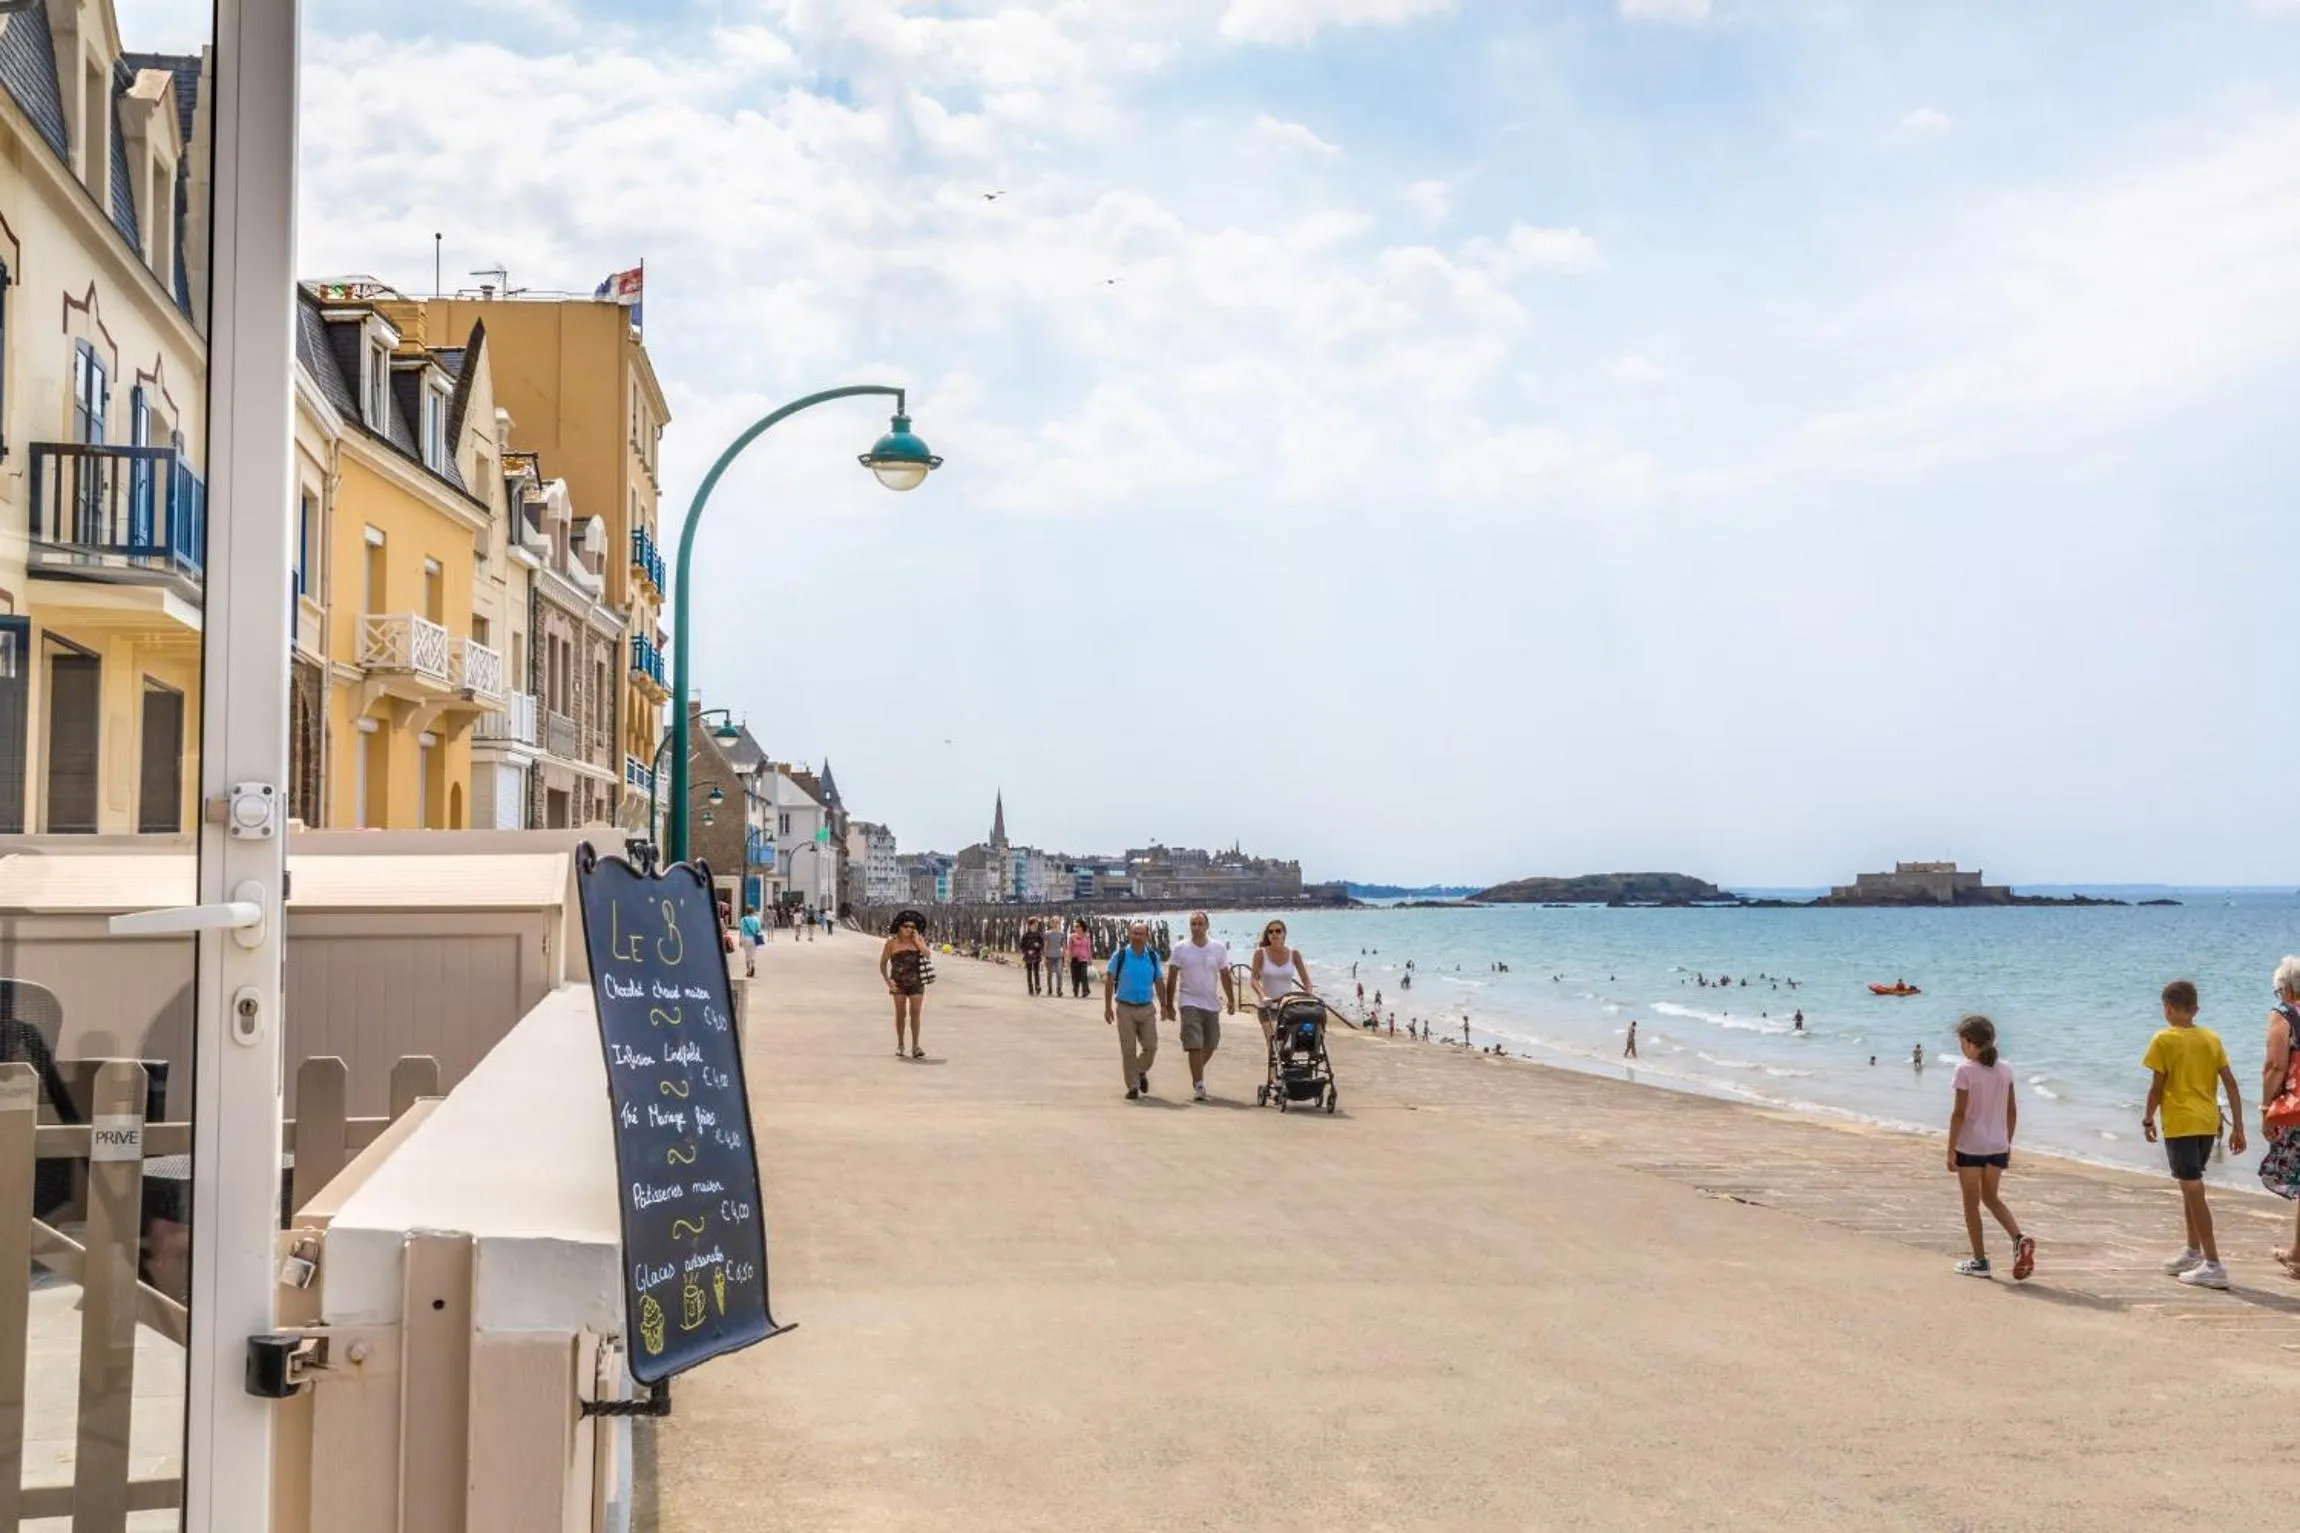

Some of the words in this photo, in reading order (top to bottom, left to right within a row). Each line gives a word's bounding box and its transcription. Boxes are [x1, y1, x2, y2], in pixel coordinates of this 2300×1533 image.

[604, 973, 645, 999] Chocolat
[652, 979, 681, 999] chaud
[684, 986, 711, 1000] maison
[620, 1101, 639, 1129] Thé
[648, 1103, 687, 1133] Mariage
[95, 1130, 139, 1145] PRIVE
[692, 1180, 725, 1193] maison
[635, 1262, 677, 1295] Glaces
